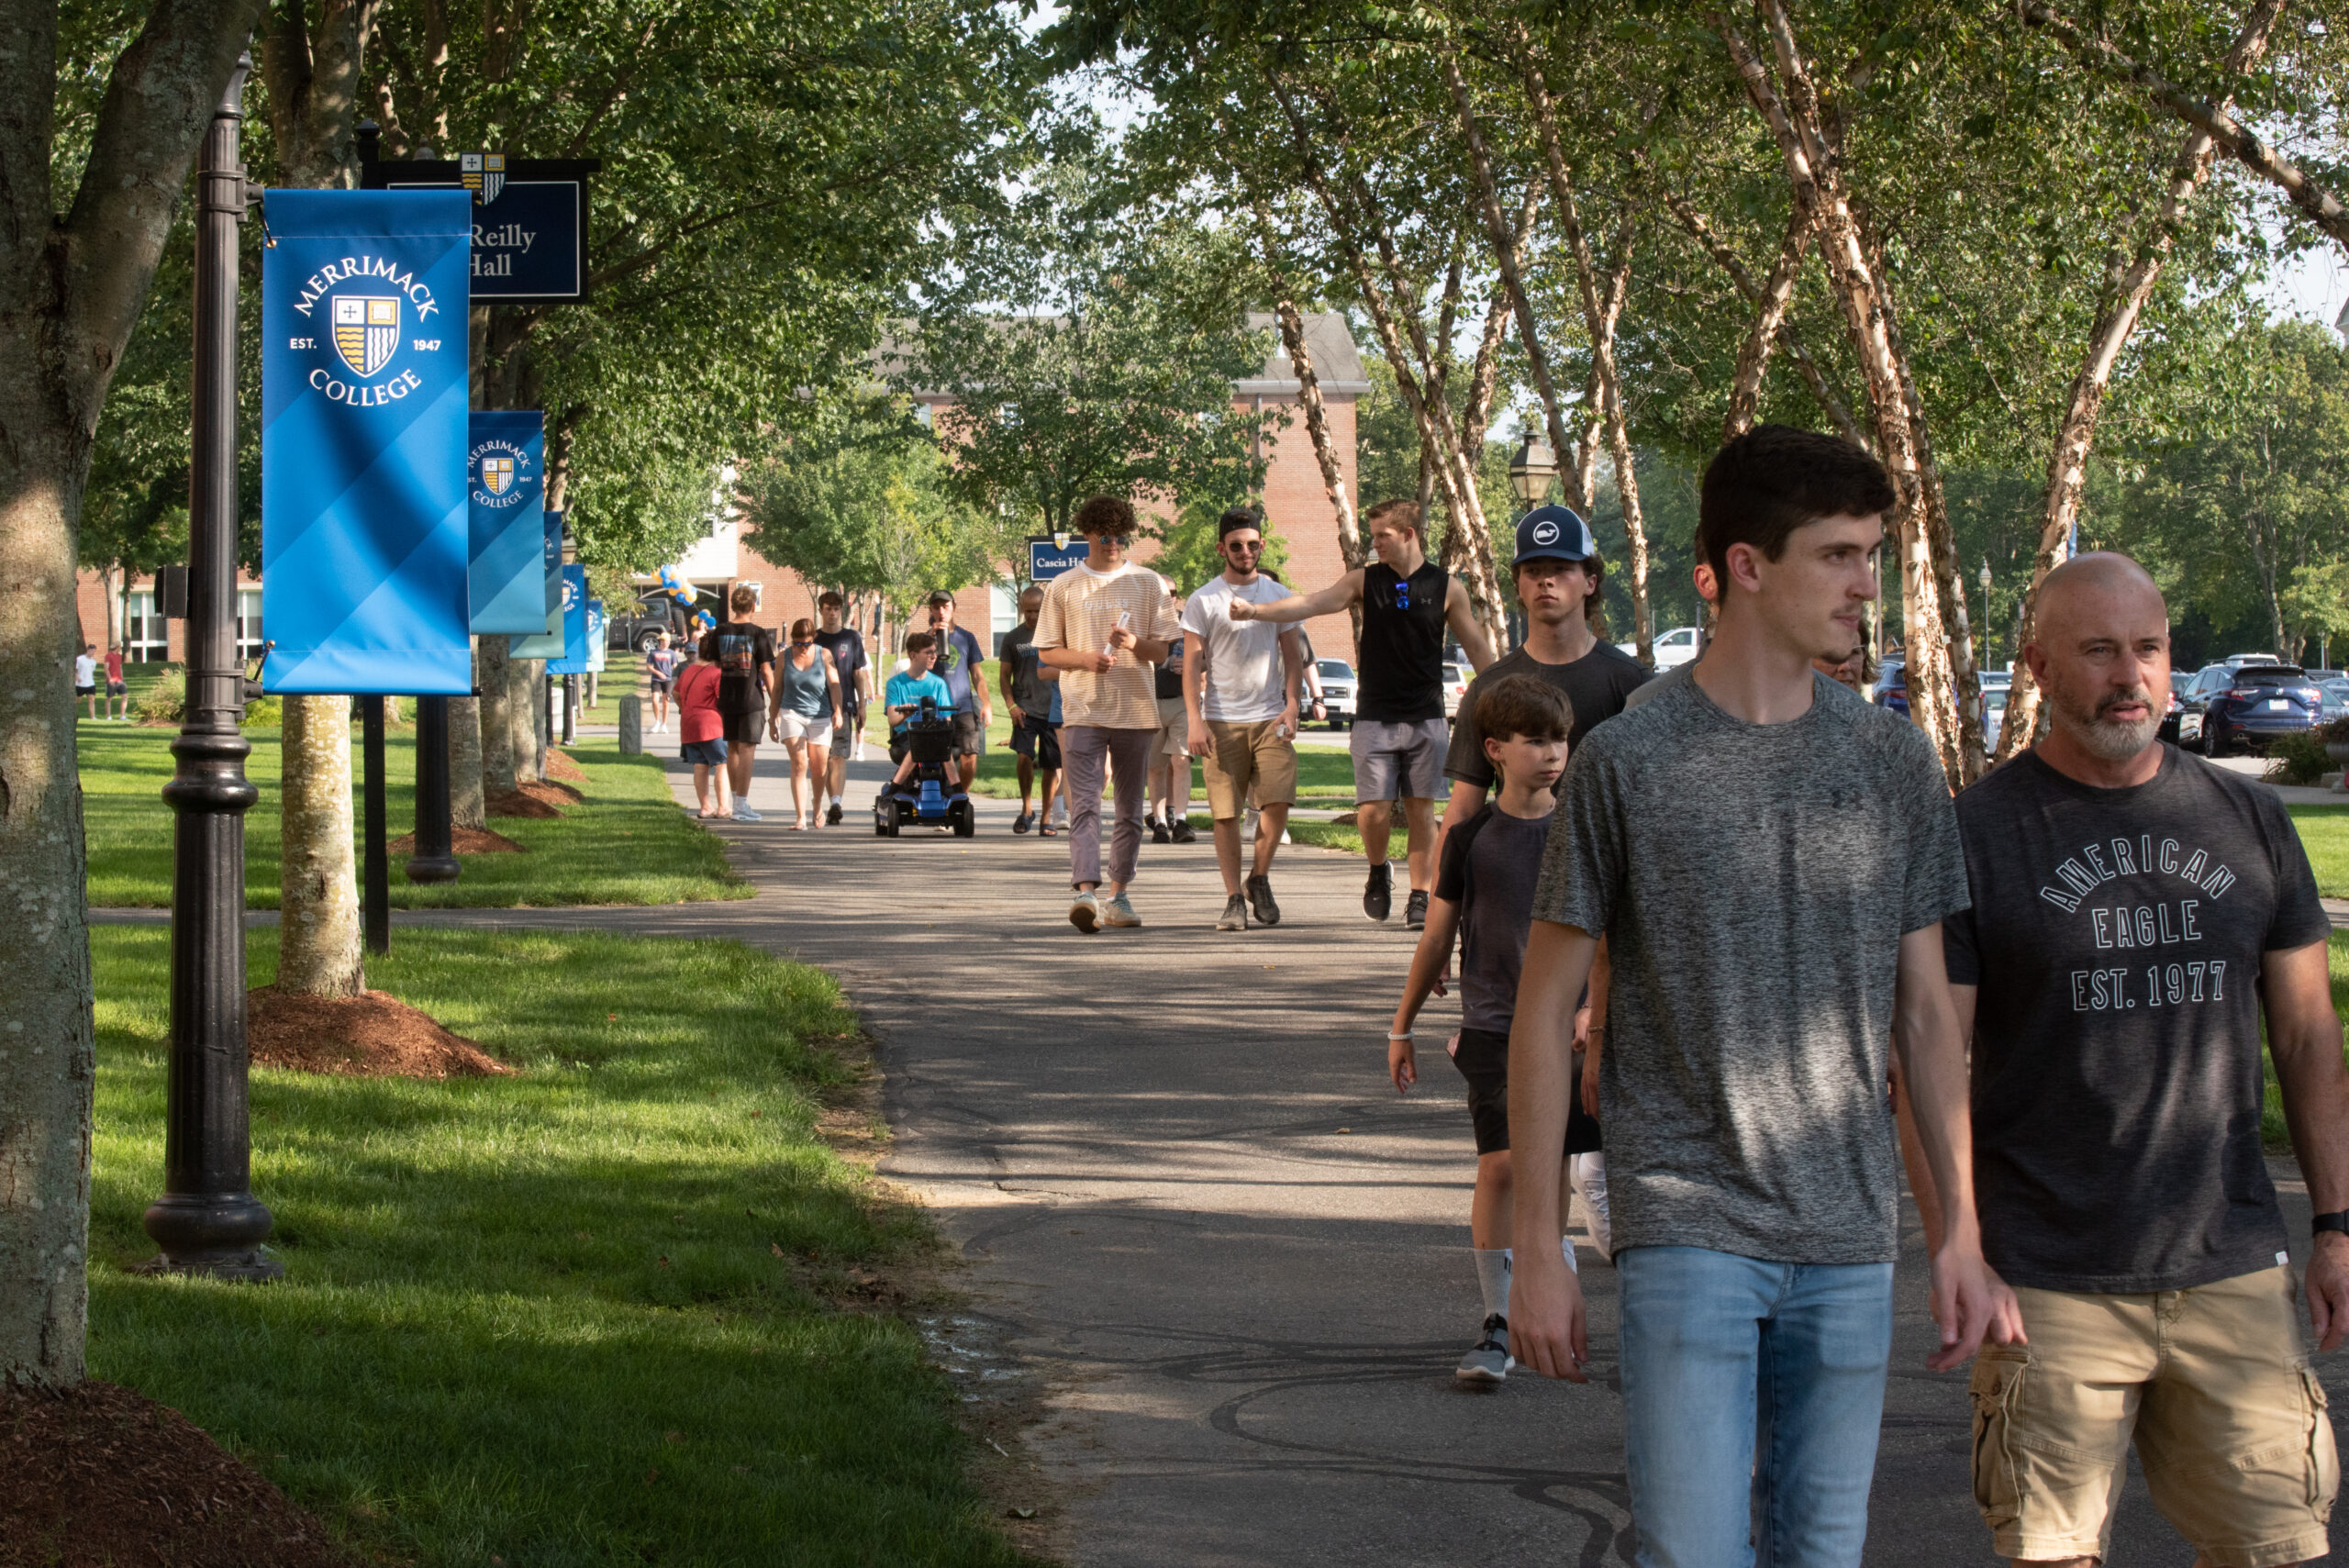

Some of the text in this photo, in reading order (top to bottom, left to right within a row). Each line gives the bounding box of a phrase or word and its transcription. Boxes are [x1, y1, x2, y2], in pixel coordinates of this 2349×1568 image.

[294, 255, 440, 323] MERRIMACK
[289, 339, 441, 350] EST. 1947
[309, 369, 422, 406] COLLEGE
[468, 439, 531, 470] MERRIMACK
[473, 490, 524, 508] COLLEGE
[1036, 557, 1085, 568] Cascia Ha
[2040, 834, 2236, 914] AMERICAN
[2091, 899, 2202, 949] EAGLE
[2071, 961, 2226, 1011] EST. 1977
